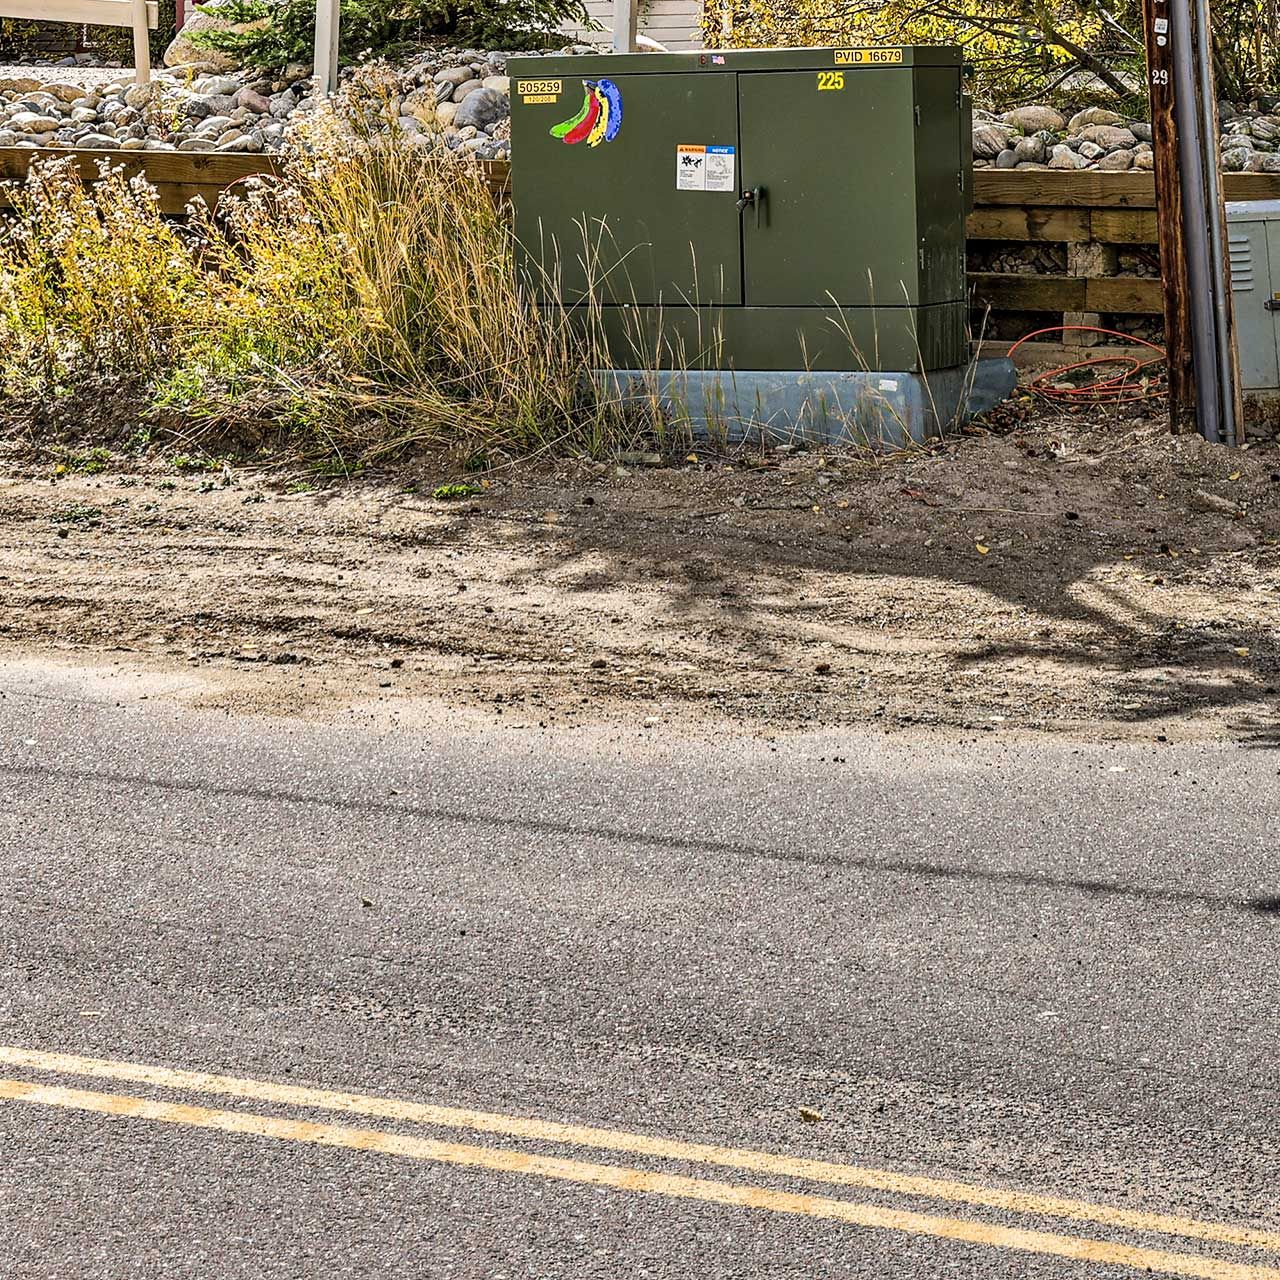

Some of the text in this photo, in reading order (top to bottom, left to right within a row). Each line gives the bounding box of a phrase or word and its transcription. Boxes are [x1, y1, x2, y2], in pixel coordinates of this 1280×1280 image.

[835, 51, 901, 62] PVID 16679
[817, 72, 845, 90] 225
[1151, 69, 1168, 85] 29
[519, 82, 560, 92] 505259
